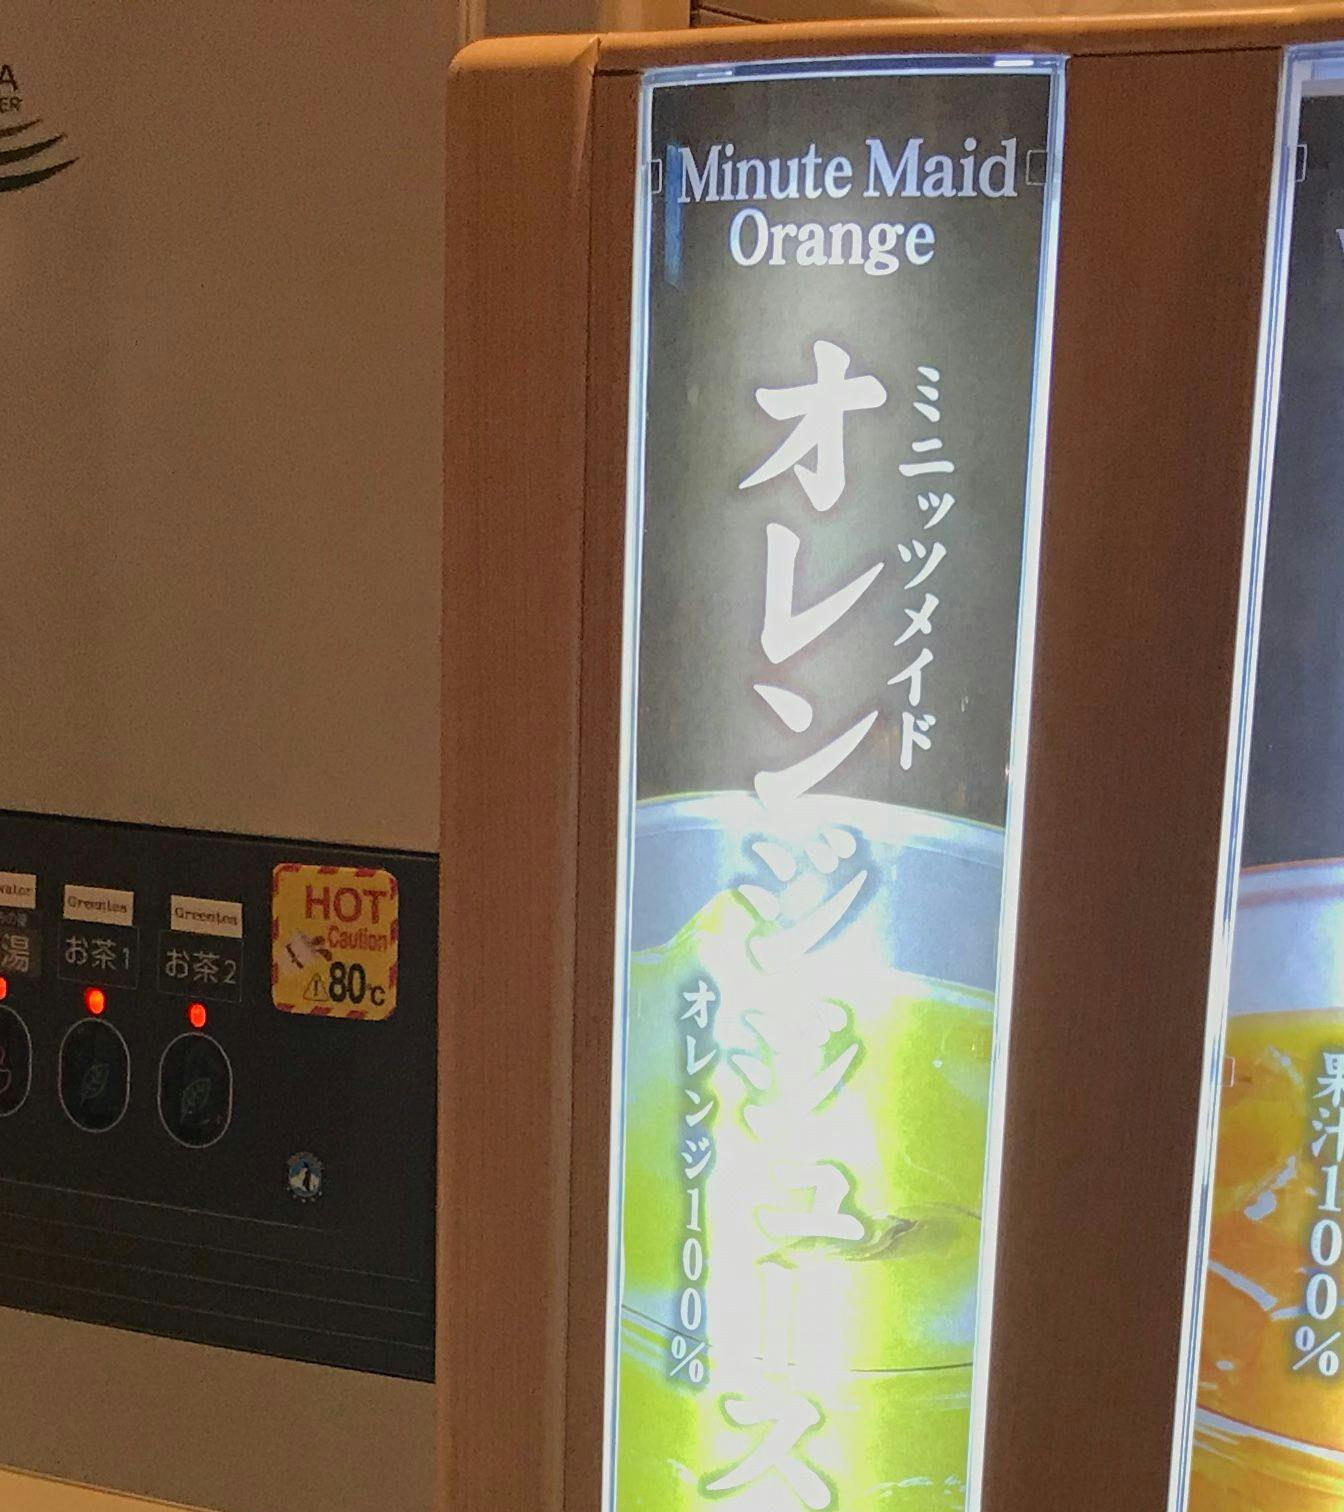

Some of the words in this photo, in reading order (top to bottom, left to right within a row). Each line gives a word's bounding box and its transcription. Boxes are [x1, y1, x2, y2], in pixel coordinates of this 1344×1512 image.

[677, 143, 852, 205] Minute
[864, 136, 1019, 200] Maid
[729, 207, 937, 276] Orange
[886, 365, 955, 771] ミニッツメイド
[305, 885, 388, 925] HOT
[327, 924, 388, 952] Caution
